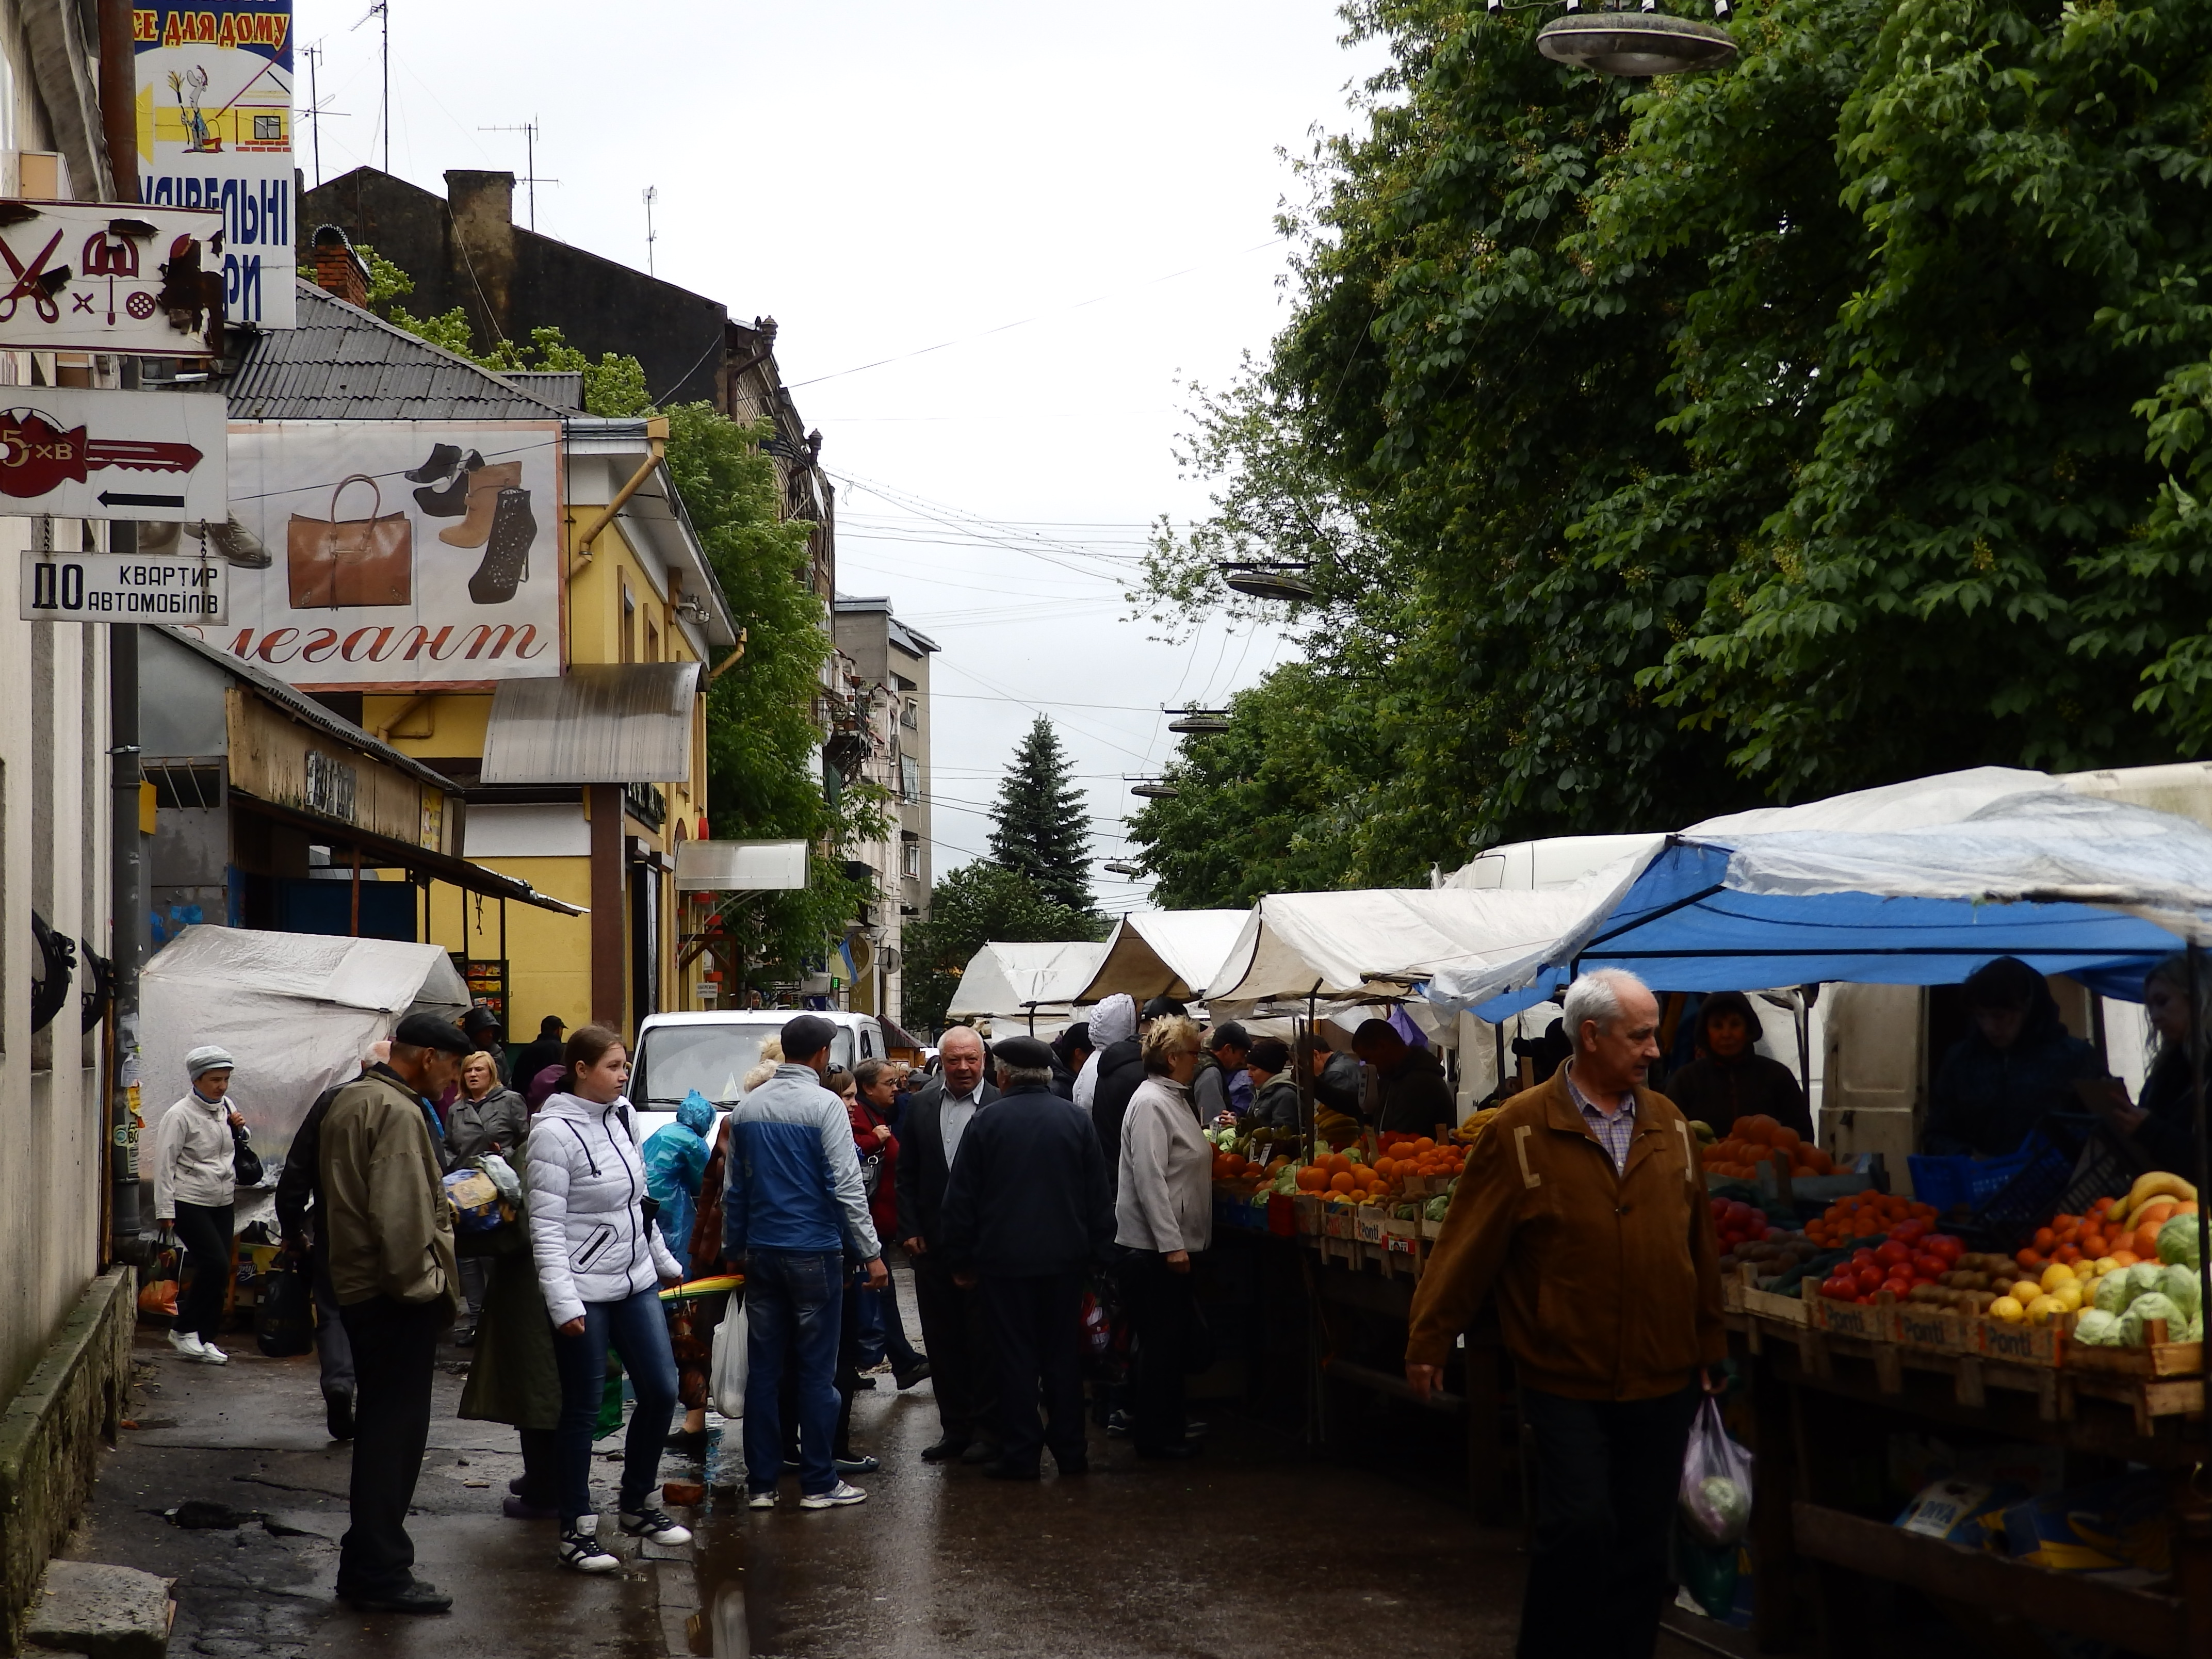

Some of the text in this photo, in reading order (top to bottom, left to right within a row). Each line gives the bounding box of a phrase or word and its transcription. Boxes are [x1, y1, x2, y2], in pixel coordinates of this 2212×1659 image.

[162, 10, 217, 48] ДЛЯ
[218, 12, 290, 52] ДОМУ
[32, 562, 218, 610] ДО КВАРТИР
[184, 624, 548, 664] легант
